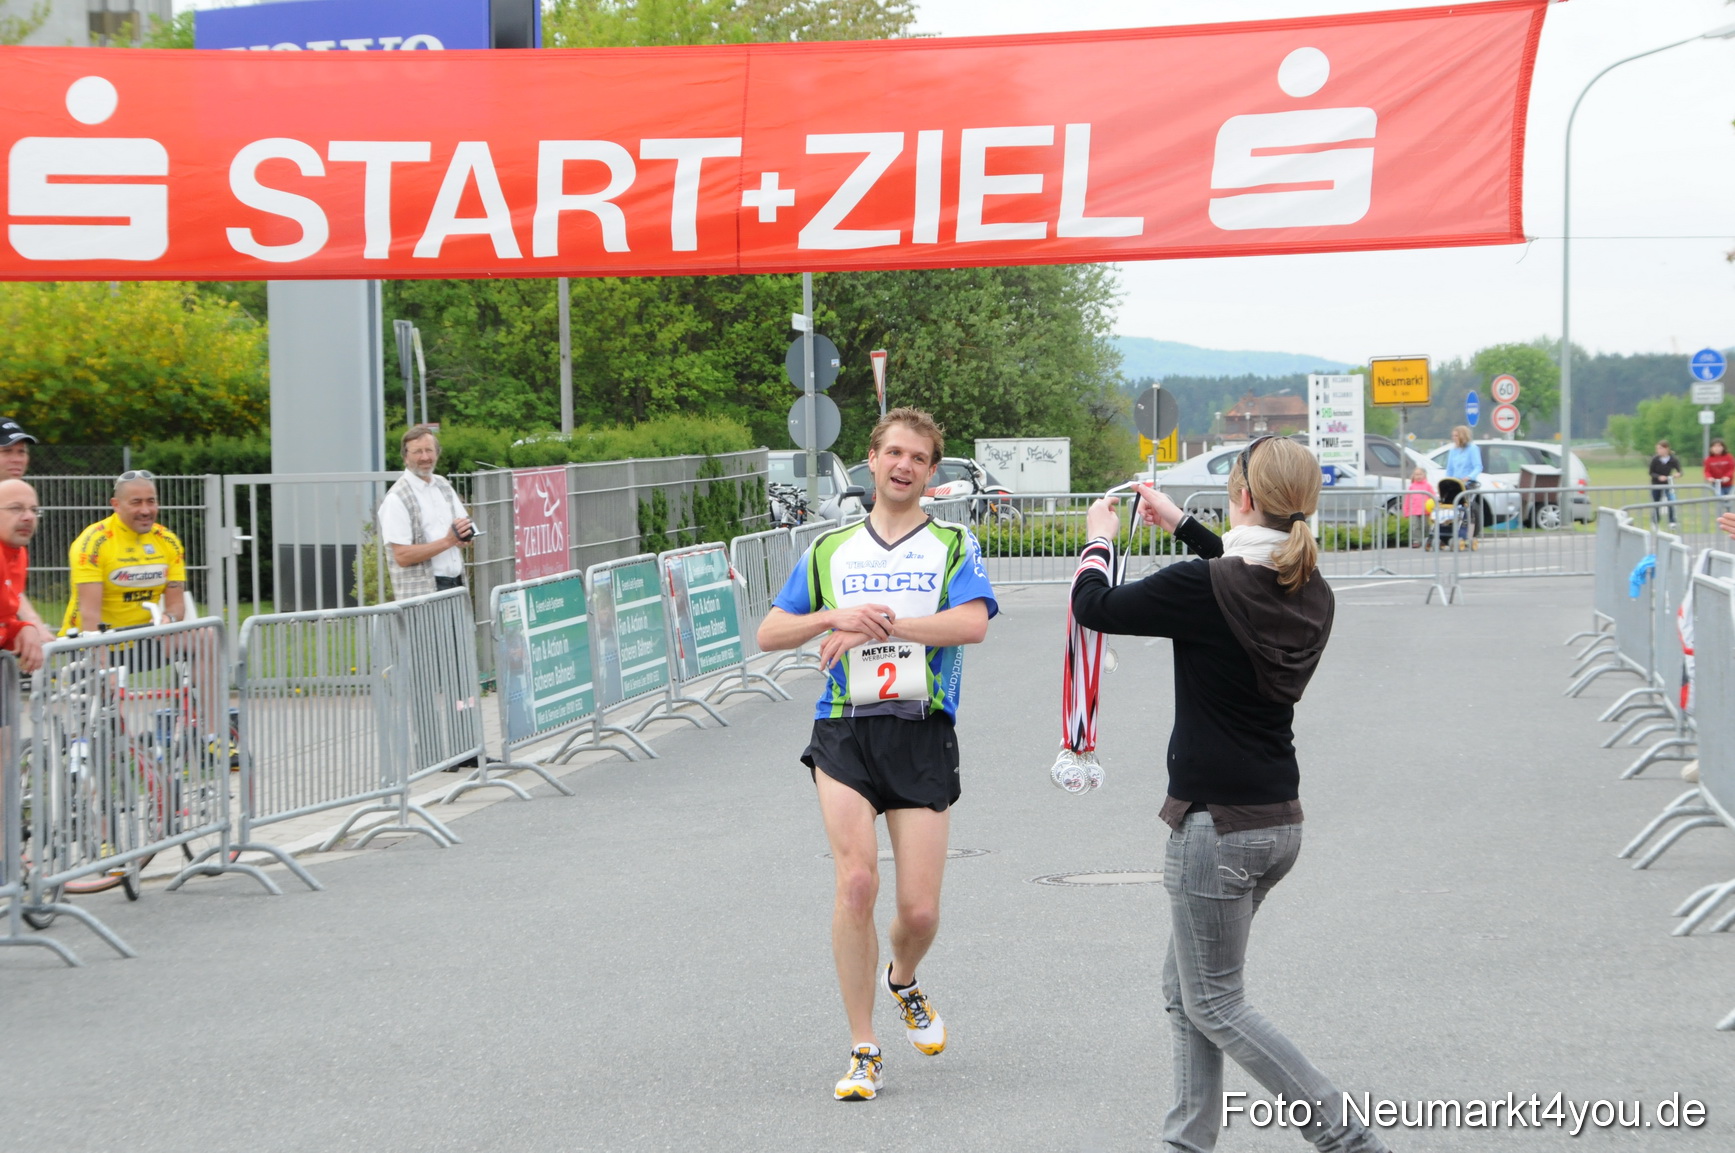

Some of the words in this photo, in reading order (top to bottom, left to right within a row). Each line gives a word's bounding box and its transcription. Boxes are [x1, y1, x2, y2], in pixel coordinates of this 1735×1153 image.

[1377, 375, 1424, 387] Neumarkt
[1500, 382, 1513, 396] 60
[1322, 438, 1339, 448] THULE
[524, 521, 564, 558] ZEITLOS
[845, 560, 888, 569] TEAM
[112, 570, 163, 581] Mercatone
[842, 571, 938, 596] BOCK
[532, 643, 542, 663] Fun
[547, 636, 563, 659] Action
[862, 646, 895, 656] MEYER
[862, 653, 896, 662] WERBUNG
[877, 662, 899, 700] 2
